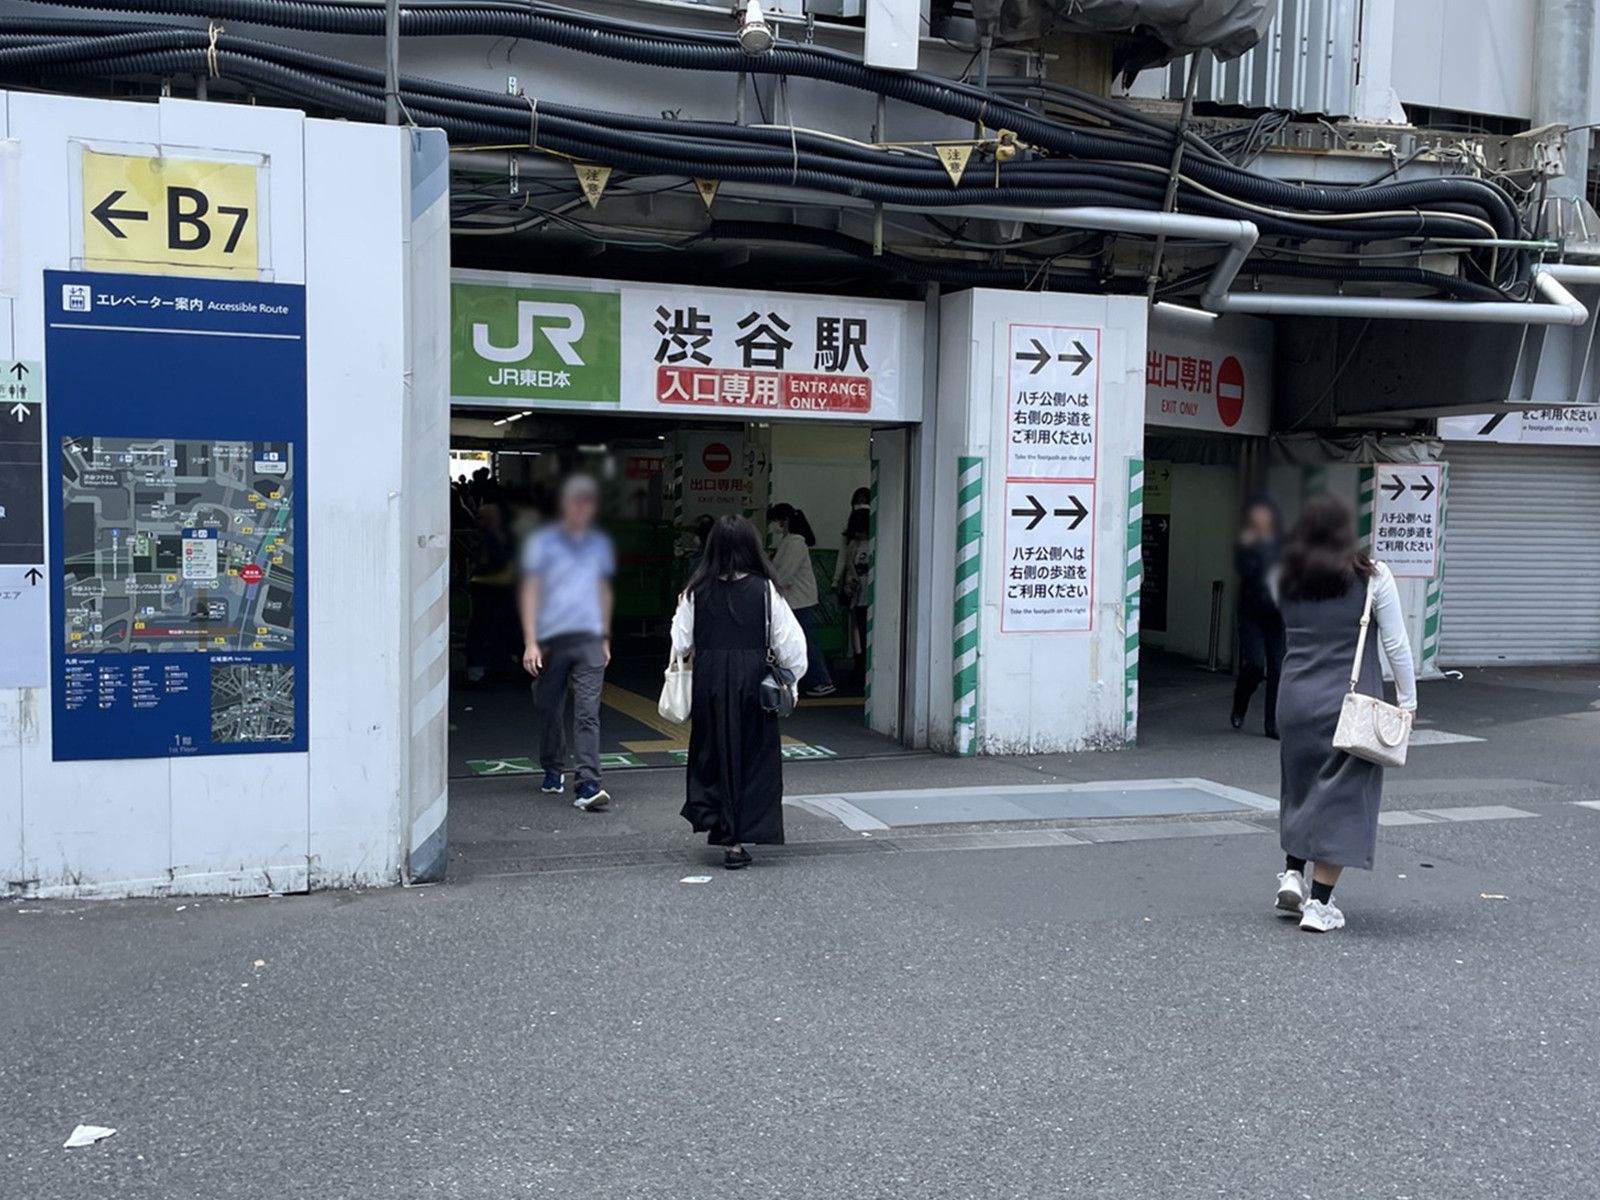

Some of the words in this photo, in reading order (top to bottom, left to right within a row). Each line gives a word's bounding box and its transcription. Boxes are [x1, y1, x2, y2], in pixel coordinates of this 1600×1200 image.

[947, 148, 961, 173] 注意
[585, 169, 600, 195] 注意
[166, 185, 249, 254] B7
[96, 294, 203, 313] エレベーター案内
[207, 300, 258, 313] Accessible
[259, 303, 289, 315] Route
[472, 300, 586, 366] JR
[653, 304, 870, 373] 渋谷駅
[488, 368, 571, 388] JR東日本
[1145, 349, 1213, 395] 出口専用
[660, 370, 779, 406] 入口専用
[790, 380, 867, 396] ENTRANCE
[789, 397, 828, 410] ONLY
[1016, 391, 1089, 407] ハチ公側へは
[1161, 399, 1178, 414] EXIT
[1179, 401, 1199, 416] ONLY
[1013, 410, 1091, 427] 右側の歩道を
[1012, 429, 1092, 445] ご利用ください
[689, 479, 744, 492] 出口専用
[1380, 512, 1433, 525] ハチ公側へは
[1378, 527, 1433, 539] 右側の歩道を
[1012, 546, 1085, 561] ハチ公側へは
[1376, 541, 1434, 552] ご利用ください
[1009, 565, 1087, 580] 右側の歩道を
[1007, 583, 1088, 599] ご利用ください
